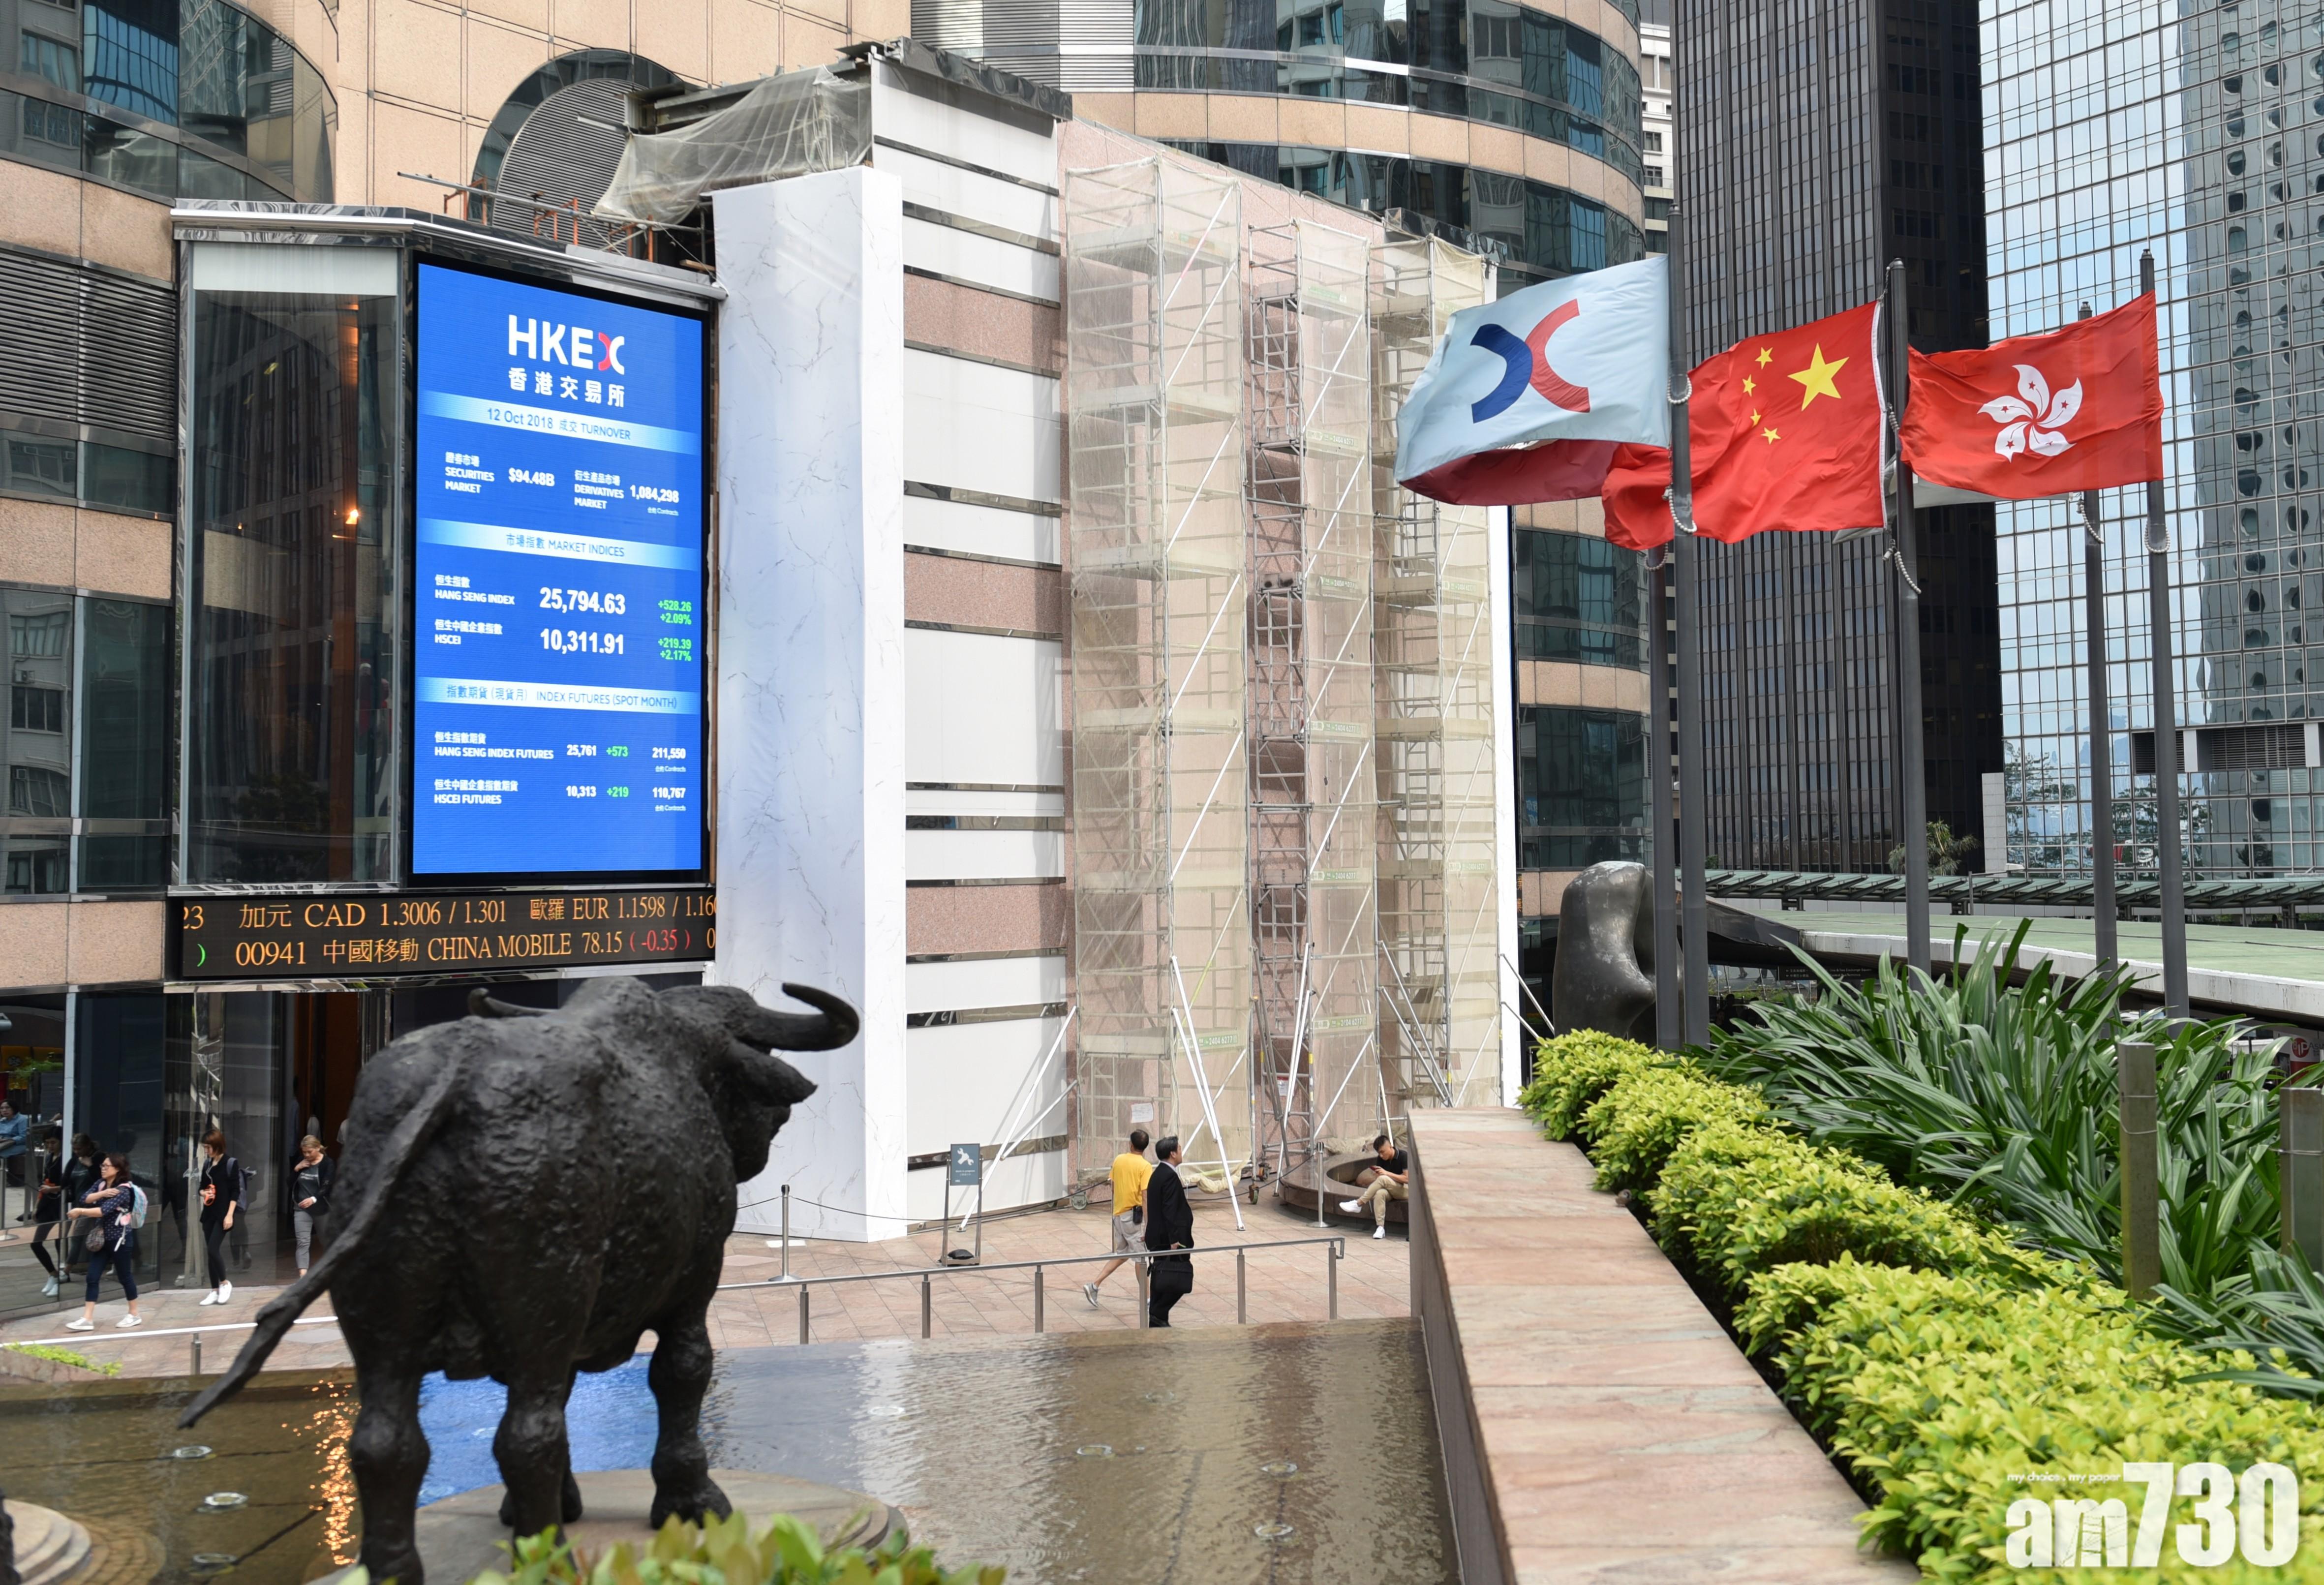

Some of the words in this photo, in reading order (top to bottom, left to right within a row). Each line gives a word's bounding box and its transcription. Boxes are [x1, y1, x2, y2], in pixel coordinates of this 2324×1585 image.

[509, 314, 625, 375] HKEX
[508, 367, 625, 408] 香港交易所
[487, 408, 500, 421] 12
[504, 410, 524, 425] Oct
[527, 414, 553, 429] 2018
[559, 419, 578, 433] 成交
[581, 423, 631, 440] TURNOVER
[445, 466, 495, 482] SECURITIES
[508, 467, 555, 487] $94.48B
[445, 480, 482, 493] MARKET
[574, 483, 625, 499] DERIVATIVES
[630, 484, 679, 504] 1,084,298
[574, 496, 608, 509] MARKET
[506, 533, 545, 549] 市場指數
[548, 539, 586, 553] MARKET
[589, 544, 625, 557] INDICES
[434, 574, 470, 588] 恒生指數
[434, 589, 461, 601] HANG
[462, 591, 487, 603] SENG
[488, 593, 516, 605] INDEX
[539, 587, 626, 615] 25,794.63
[658, 600, 692, 612] +528.26
[660, 612, 692, 625] +2.09%
[434, 634, 461, 645] HSCEI
[540, 628, 624, 655] 10,311.91
[658, 638, 692, 649] +219.39
[660, 649, 692, 662] +2.17%
[536, 691, 566, 701] INDEX
[568, 693, 611, 704] FUTURES
[613, 694, 639, 706] (SPOT
[641, 696, 677, 709] MONTH)
[434, 746, 461, 757] HANG
[462, 747, 487, 758] SENG
[488, 748, 515, 758] INDEX
[516, 749, 554, 760] FUTURES
[566, 744, 597, 758] 25,761
[606, 746, 629, 757] +573
[652, 747, 686, 760] 211,550
[434, 794, 460, 804] HSCEI
[462, 794, 502, 804] FUTURES
[566, 785, 597, 798] 10,313
[607, 786, 629, 797] +219
[652, 787, 686, 800] 110,767
[239, 903, 292, 929] 加元
[304, 903, 366, 928] CAD
[380, 901, 441, 926] 1.3006
[464, 900, 507, 923] 1.301
[530, 898, 565, 920] 歐羅
[572, 897, 610, 920] EUR
[618, 896, 666, 919] 1.1598
[236, 942, 306, 966] 00941
[323, 938, 419, 964] 中國移動
[428, 937, 492, 961] CHINA
[497, 933, 572, 958] MOBILE
[581, 931, 622, 954] 78.15
